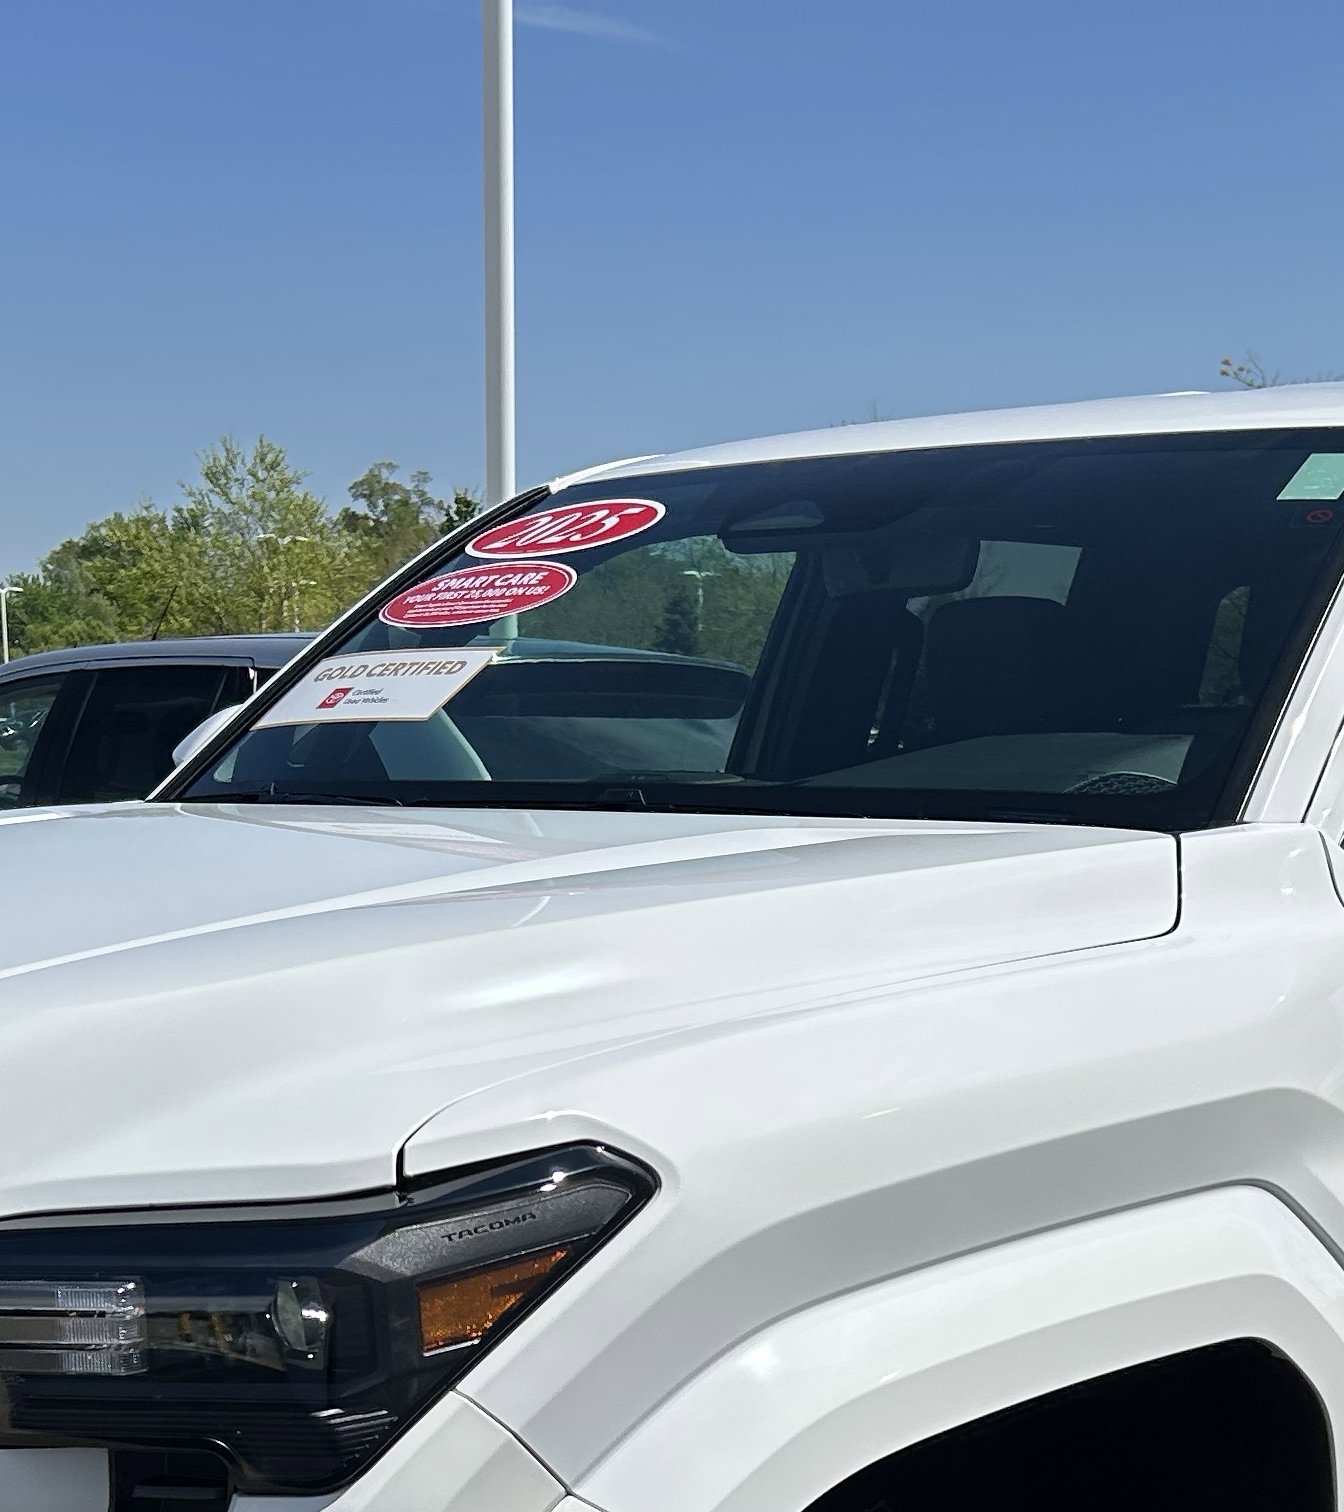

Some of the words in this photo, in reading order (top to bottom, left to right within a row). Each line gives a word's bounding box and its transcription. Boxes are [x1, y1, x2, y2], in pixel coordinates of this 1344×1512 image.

[481, 507, 648, 550] 2025
[431, 575, 499, 591] SMART
[494, 571, 550, 587] CARE
[403, 592, 436, 604] YOUR
[435, 590, 465, 601] FIRST
[504, 586, 527, 597] ON
[526, 585, 551, 596] US!
[314, 664, 369, 682] GOLD
[366, 660, 467, 678] CERTIFIED
[441, 1212, 537, 1242] TACOMA
